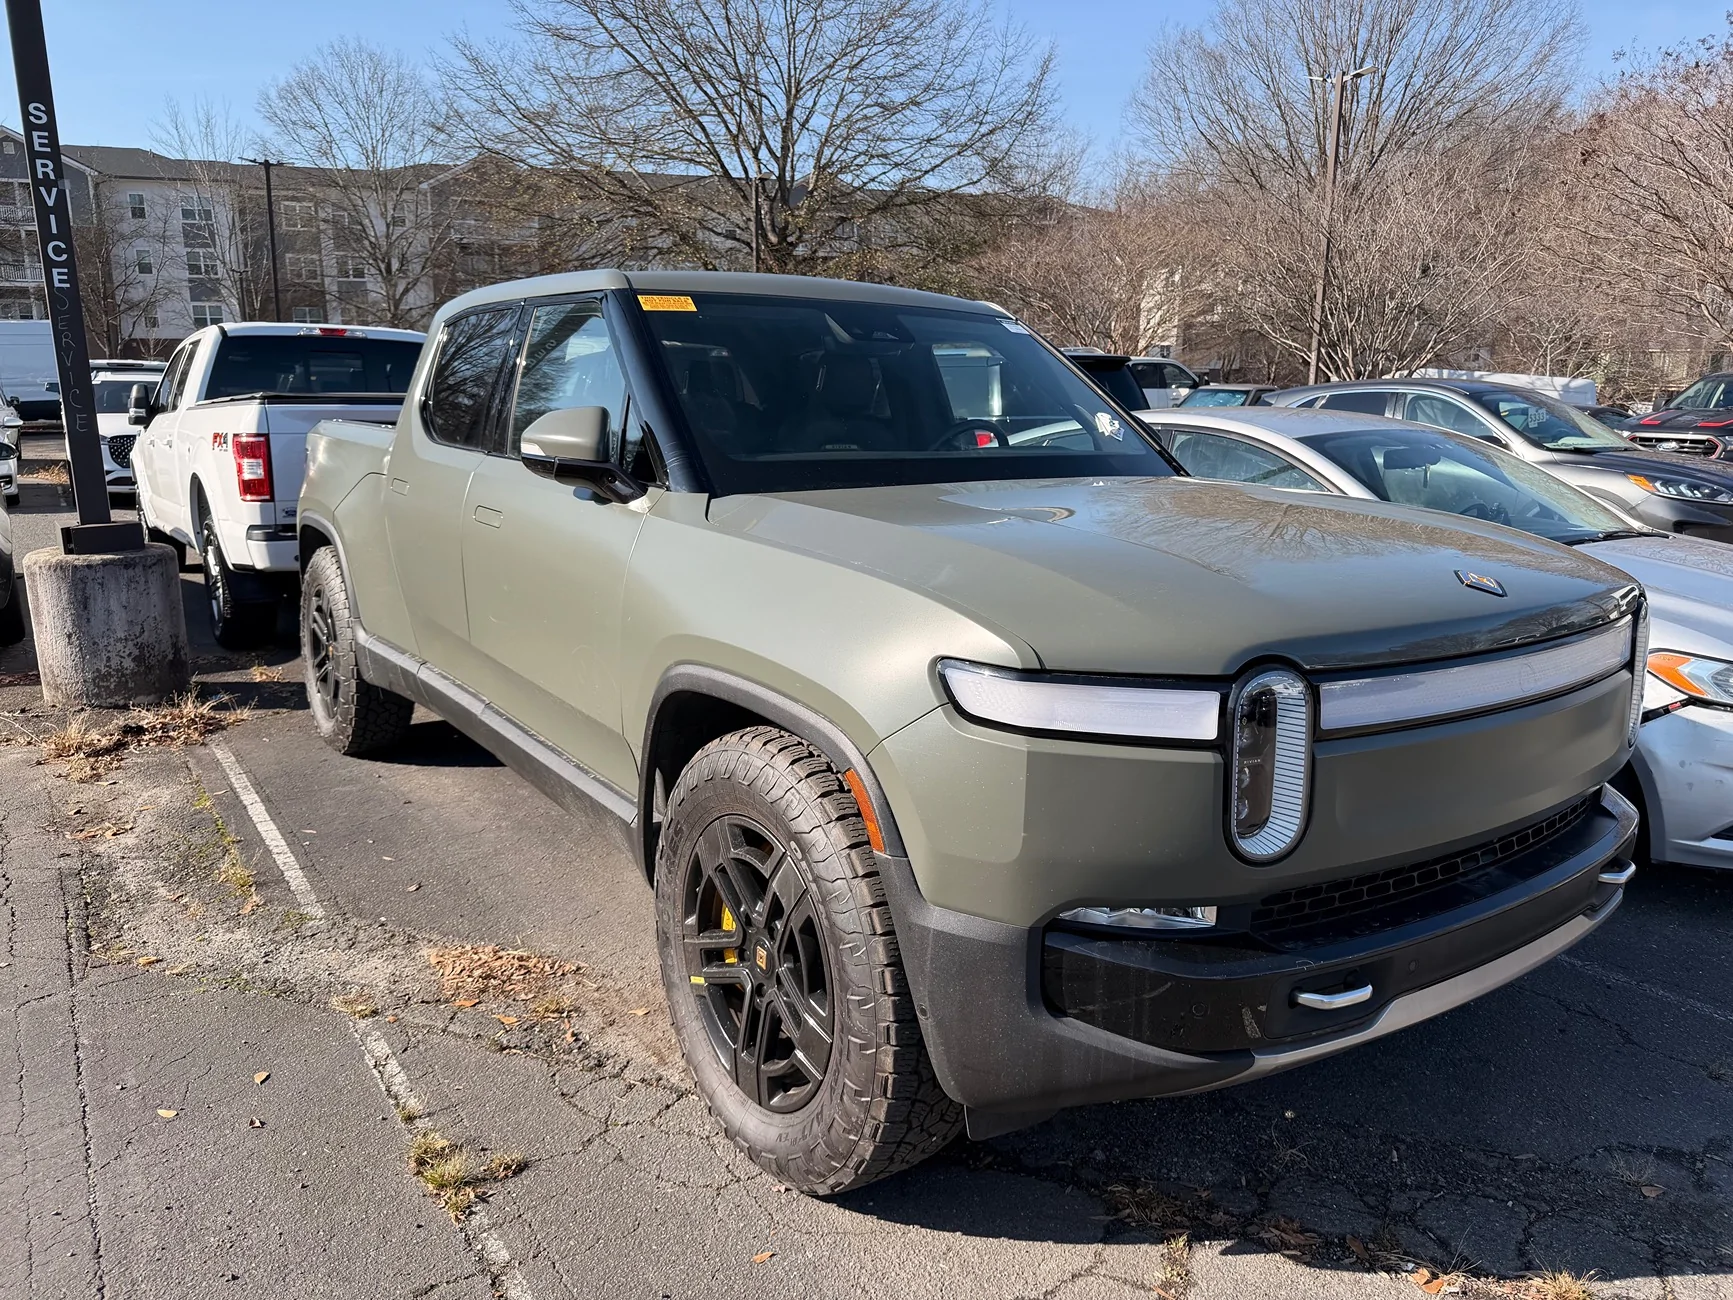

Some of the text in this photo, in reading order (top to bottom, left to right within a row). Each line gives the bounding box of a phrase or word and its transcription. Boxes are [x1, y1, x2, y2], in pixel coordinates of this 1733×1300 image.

[28, 102, 71, 288] SERVICE
[54, 287, 88, 432] SERVICE
[212, 432, 229, 450] FX4
